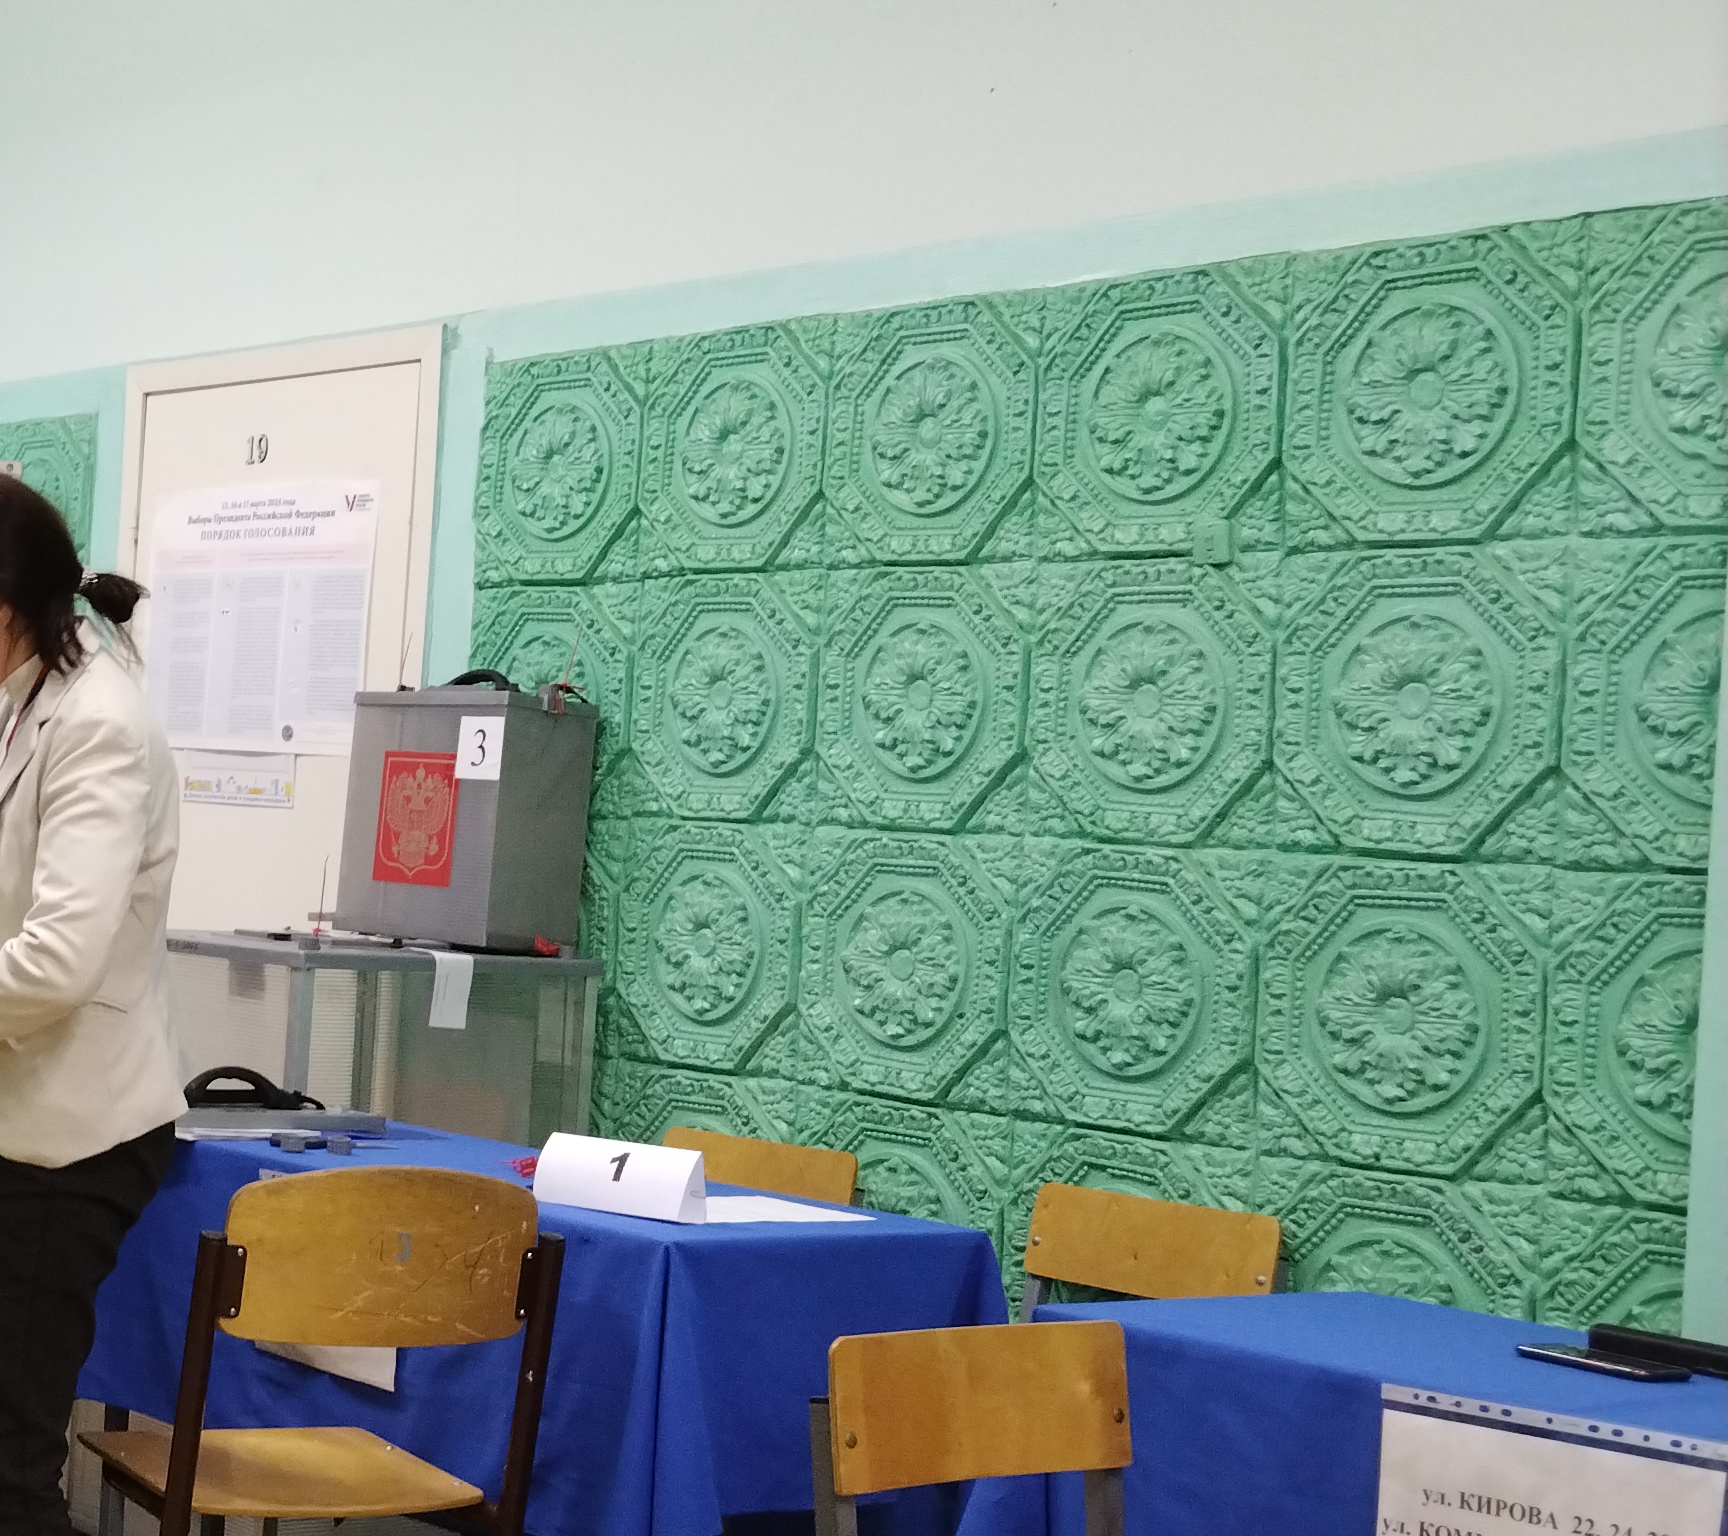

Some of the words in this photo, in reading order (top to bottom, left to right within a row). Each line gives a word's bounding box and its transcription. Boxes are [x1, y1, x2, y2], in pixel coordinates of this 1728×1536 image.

[246, 434, 268, 465] 19
[200, 529, 242, 541] ПОРЯДОК
[243, 525, 316, 539] ГОЛОСОВАНИЯ
[471, 729, 486, 766] 3
[610, 1152, 631, 1182] 1
[1421, 1488, 1452, 1507] ул.
[1458, 1490, 1559, 1530] КИРОВА
[1381, 1517, 1411, 1536] ул.
